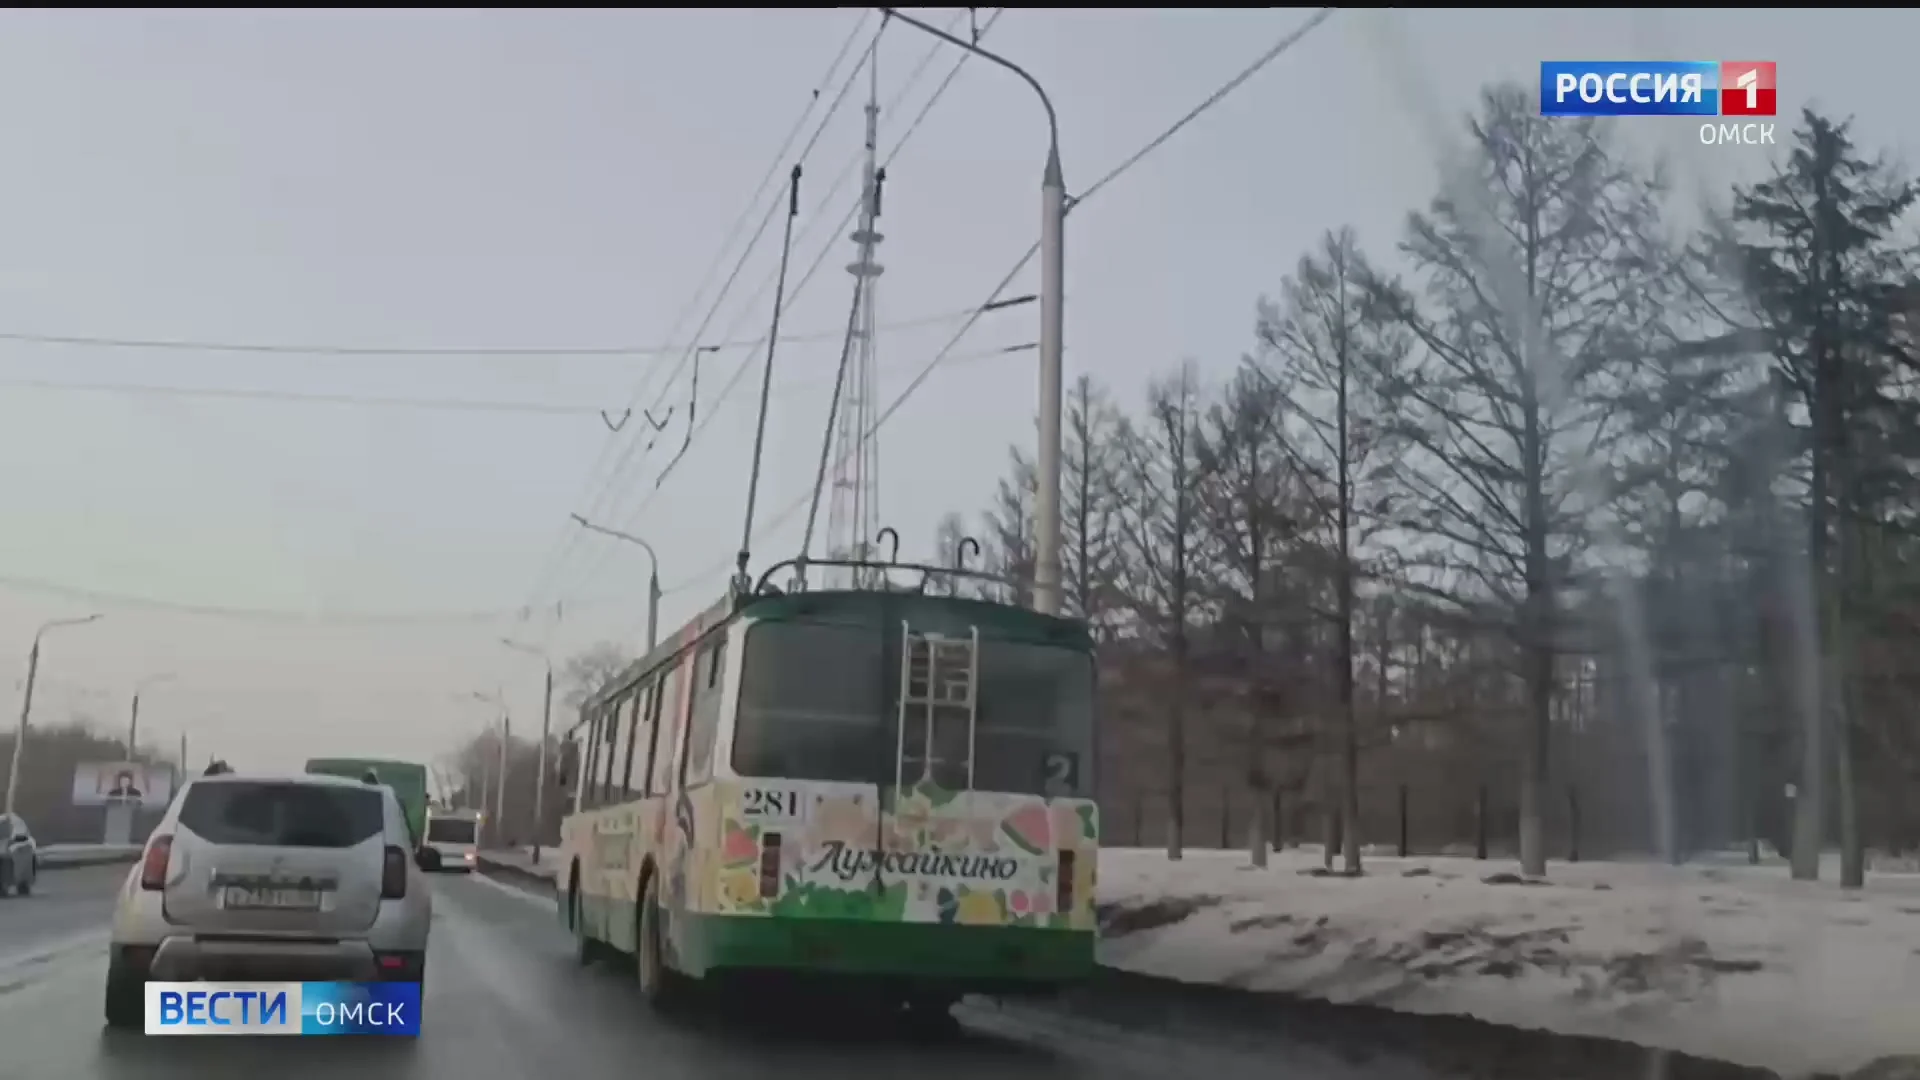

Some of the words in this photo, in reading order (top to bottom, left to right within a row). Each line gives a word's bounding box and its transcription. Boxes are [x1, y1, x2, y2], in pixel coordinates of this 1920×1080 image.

[1045, 754, 1071, 793] 2
[743, 787, 798, 816] 281
[811, 839, 1018, 882] Лужайкино
